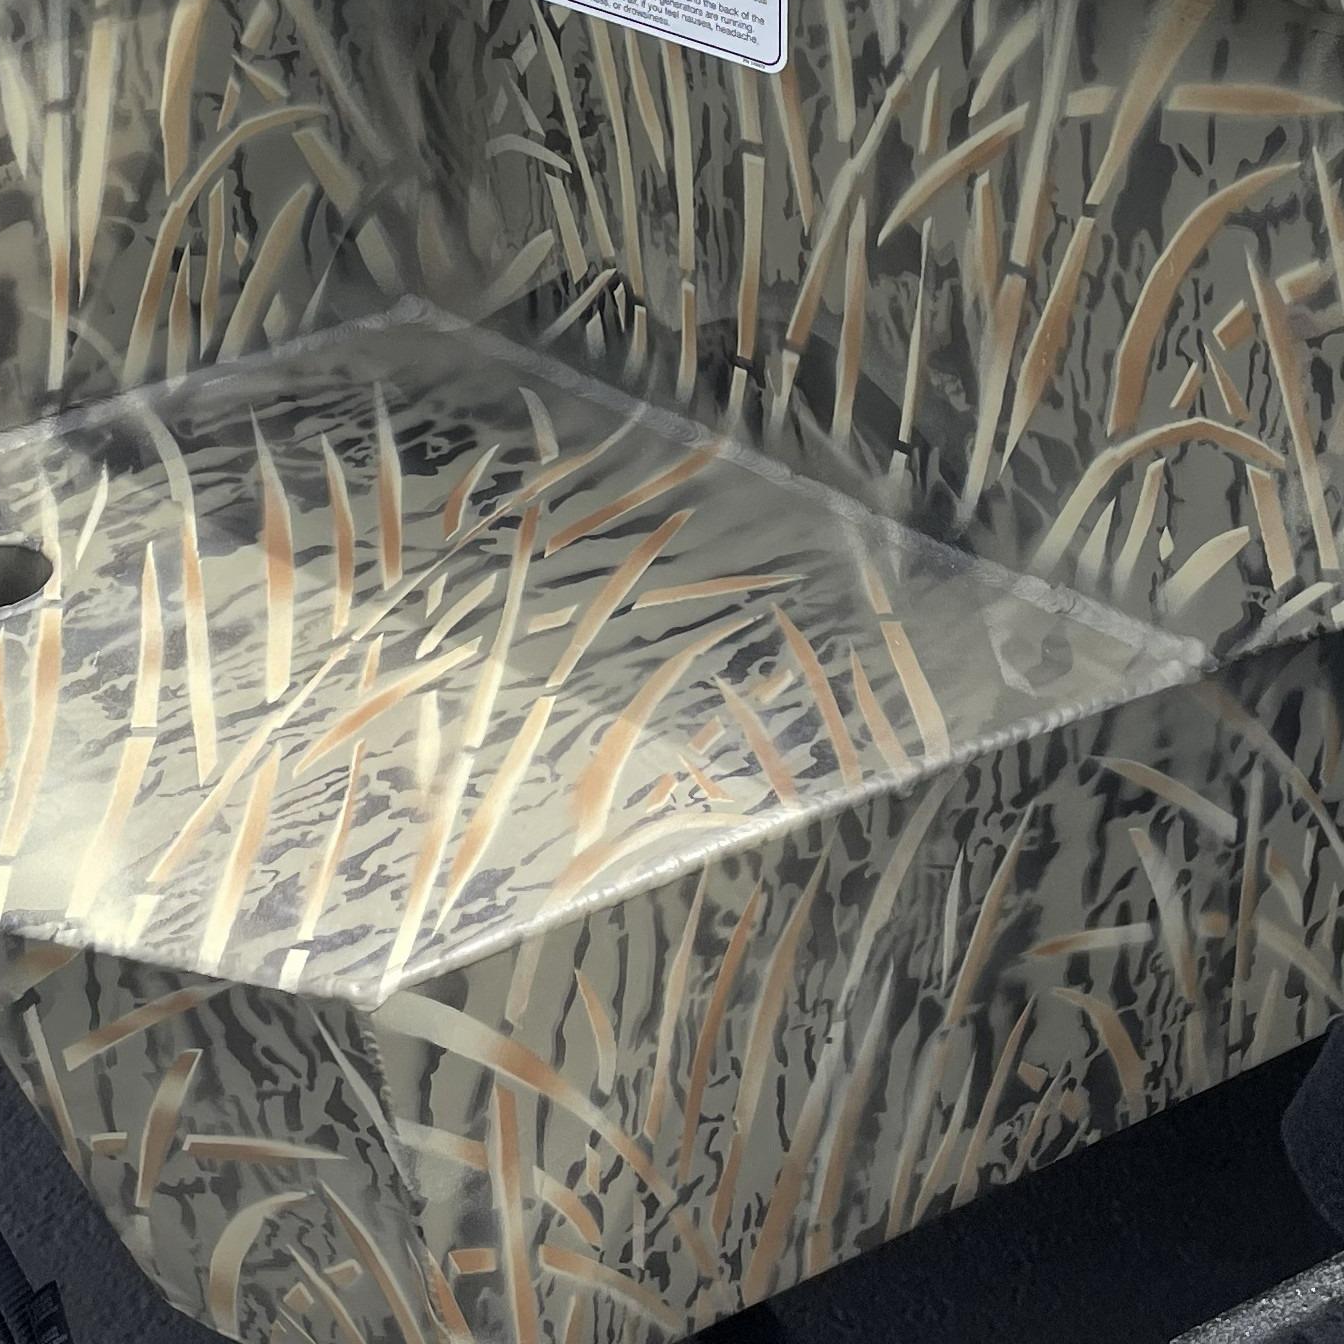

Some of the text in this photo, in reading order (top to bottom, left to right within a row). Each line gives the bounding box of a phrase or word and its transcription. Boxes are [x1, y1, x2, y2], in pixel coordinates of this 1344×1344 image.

[612, 1, 620, 10] or
[648, 3, 662, 13] you
[664, 6, 679, 18] feel
[704, 10, 718, 20] are
[718, 2, 739, 16] back
[740, 11, 749, 20] of
[751, 13, 764, 25] the
